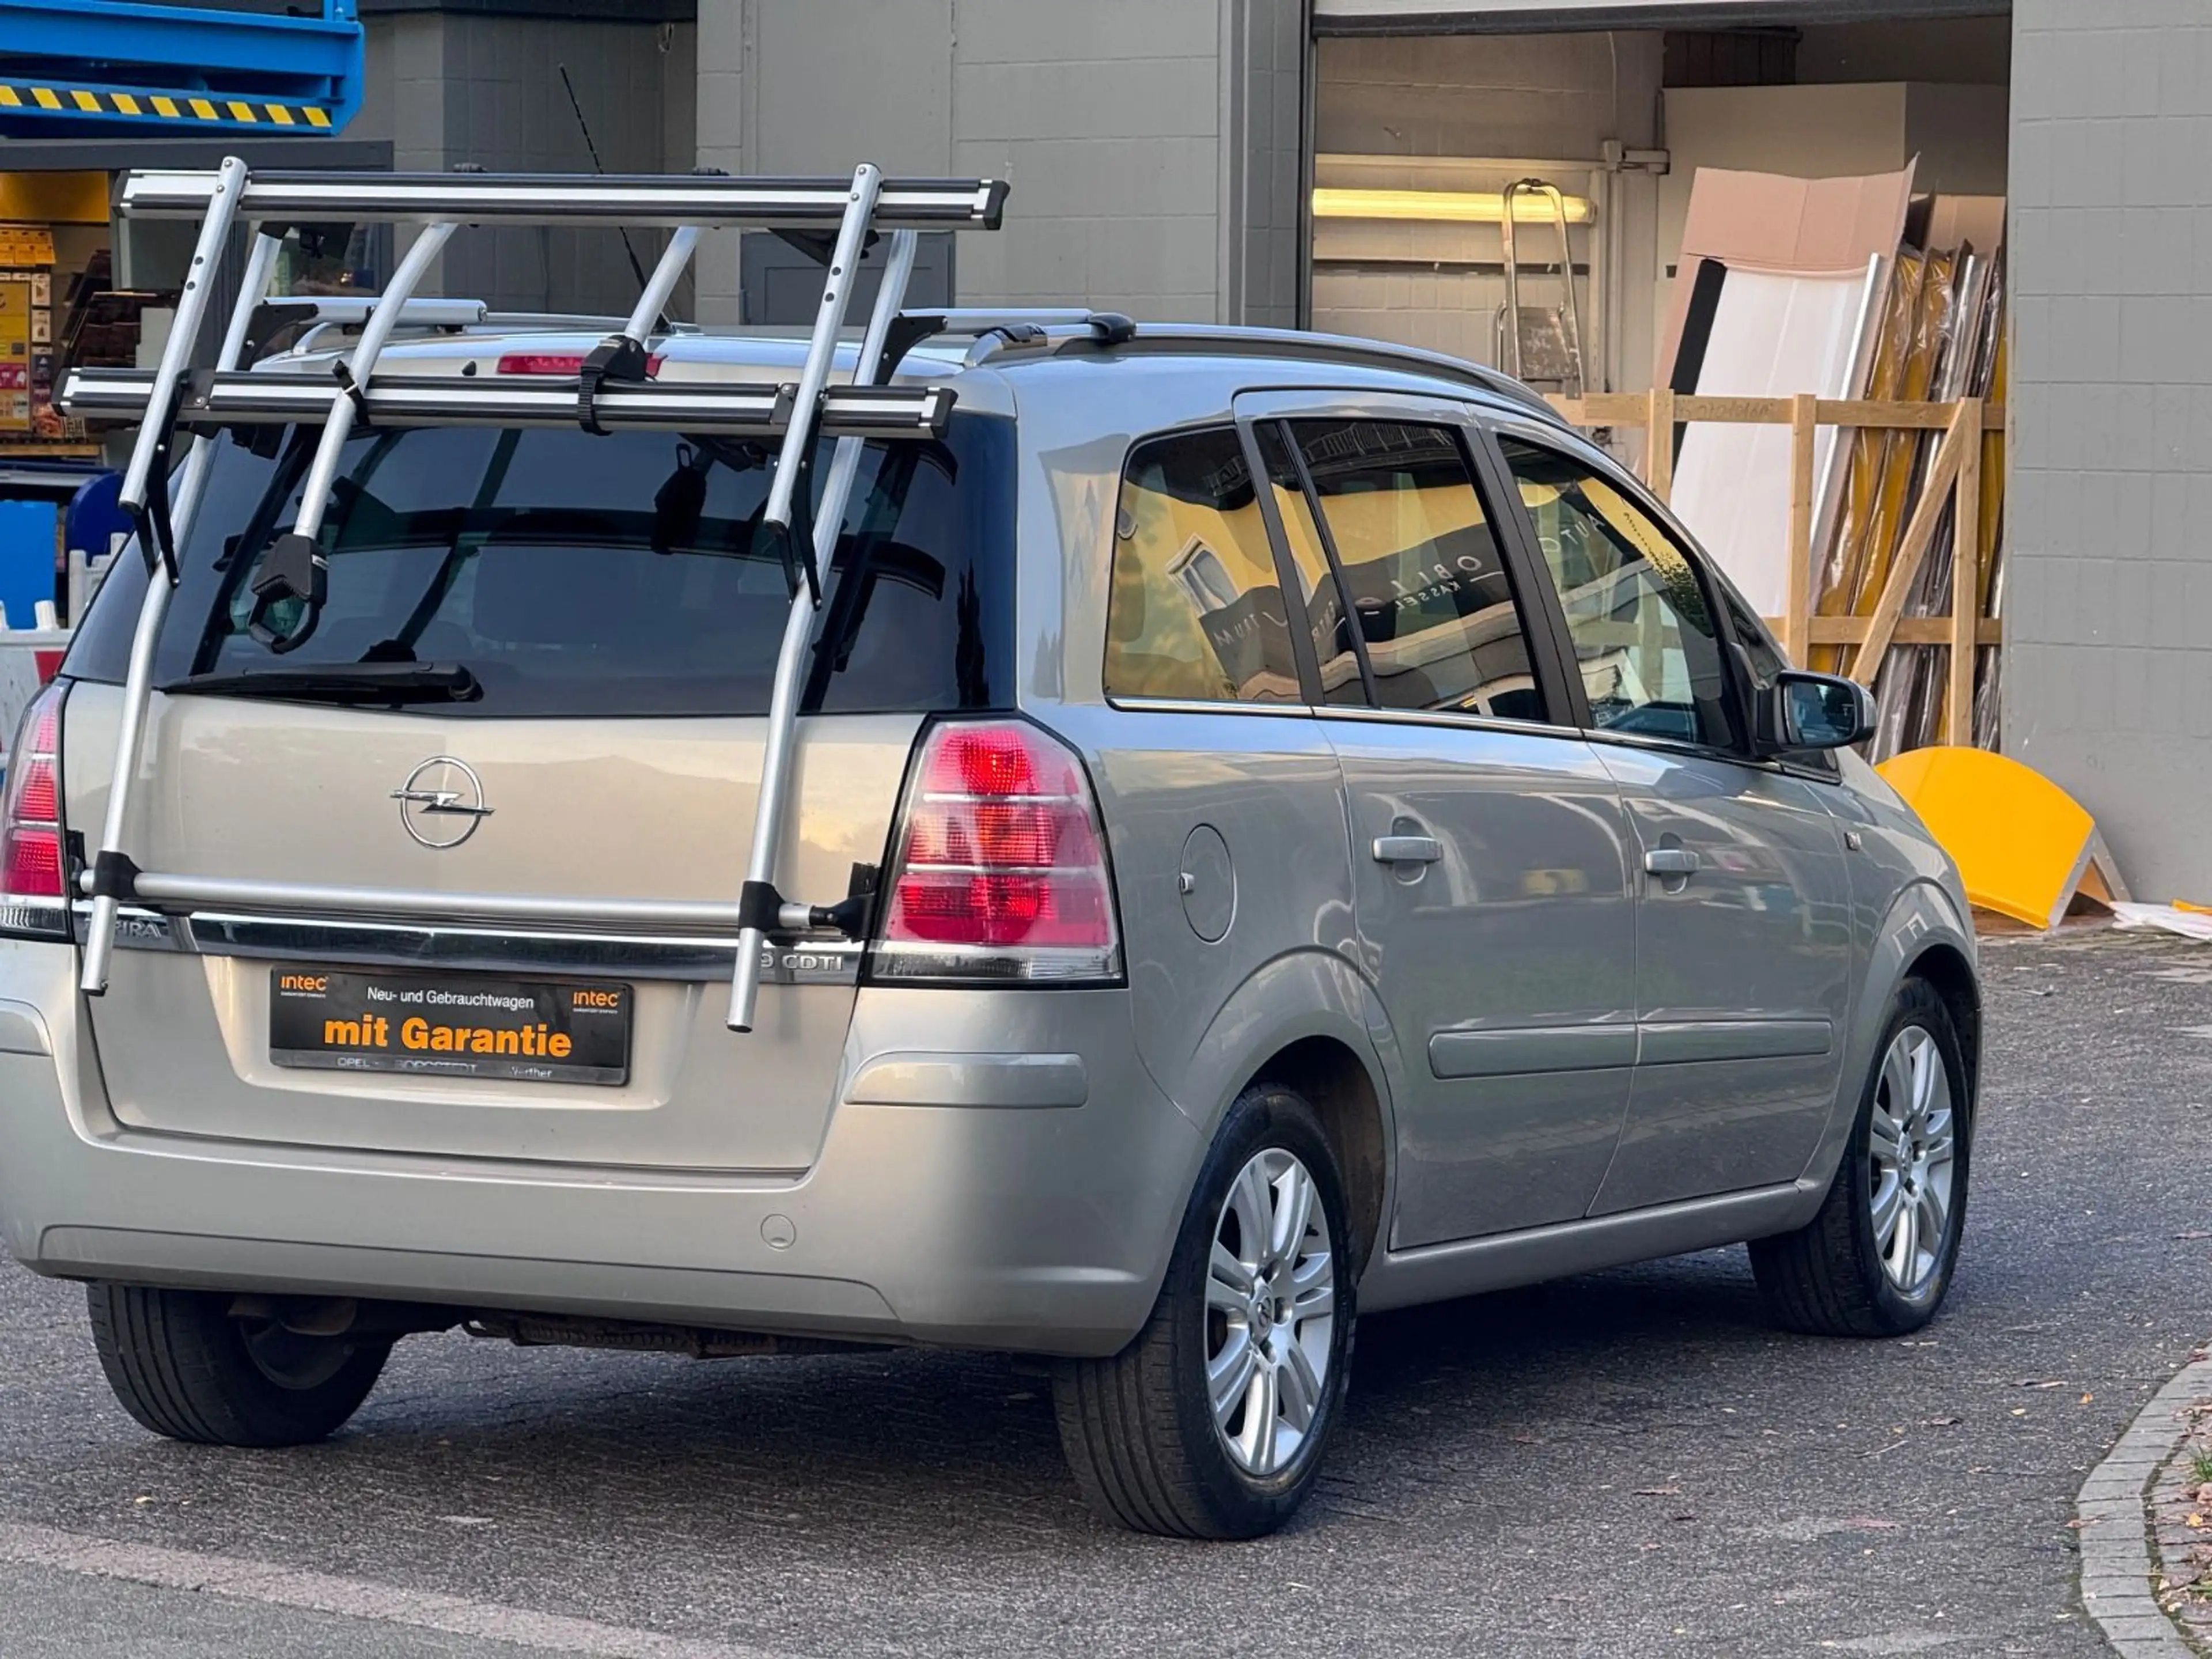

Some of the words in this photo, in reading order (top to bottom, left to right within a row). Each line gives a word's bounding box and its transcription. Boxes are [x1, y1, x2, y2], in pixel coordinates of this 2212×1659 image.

[782, 954, 843, 971] CDTI
[281, 975, 327, 991] intec
[368, 986, 397, 1001] Neu-
[400, 990, 423, 1003] und
[426, 990, 535, 1011] Gebrauchtwagen
[573, 991, 618, 1007] intec
[324, 1013, 389, 1047] mit
[401, 1017, 572, 1058] Garantie
[337, 1058, 370, 1069] OPEL
